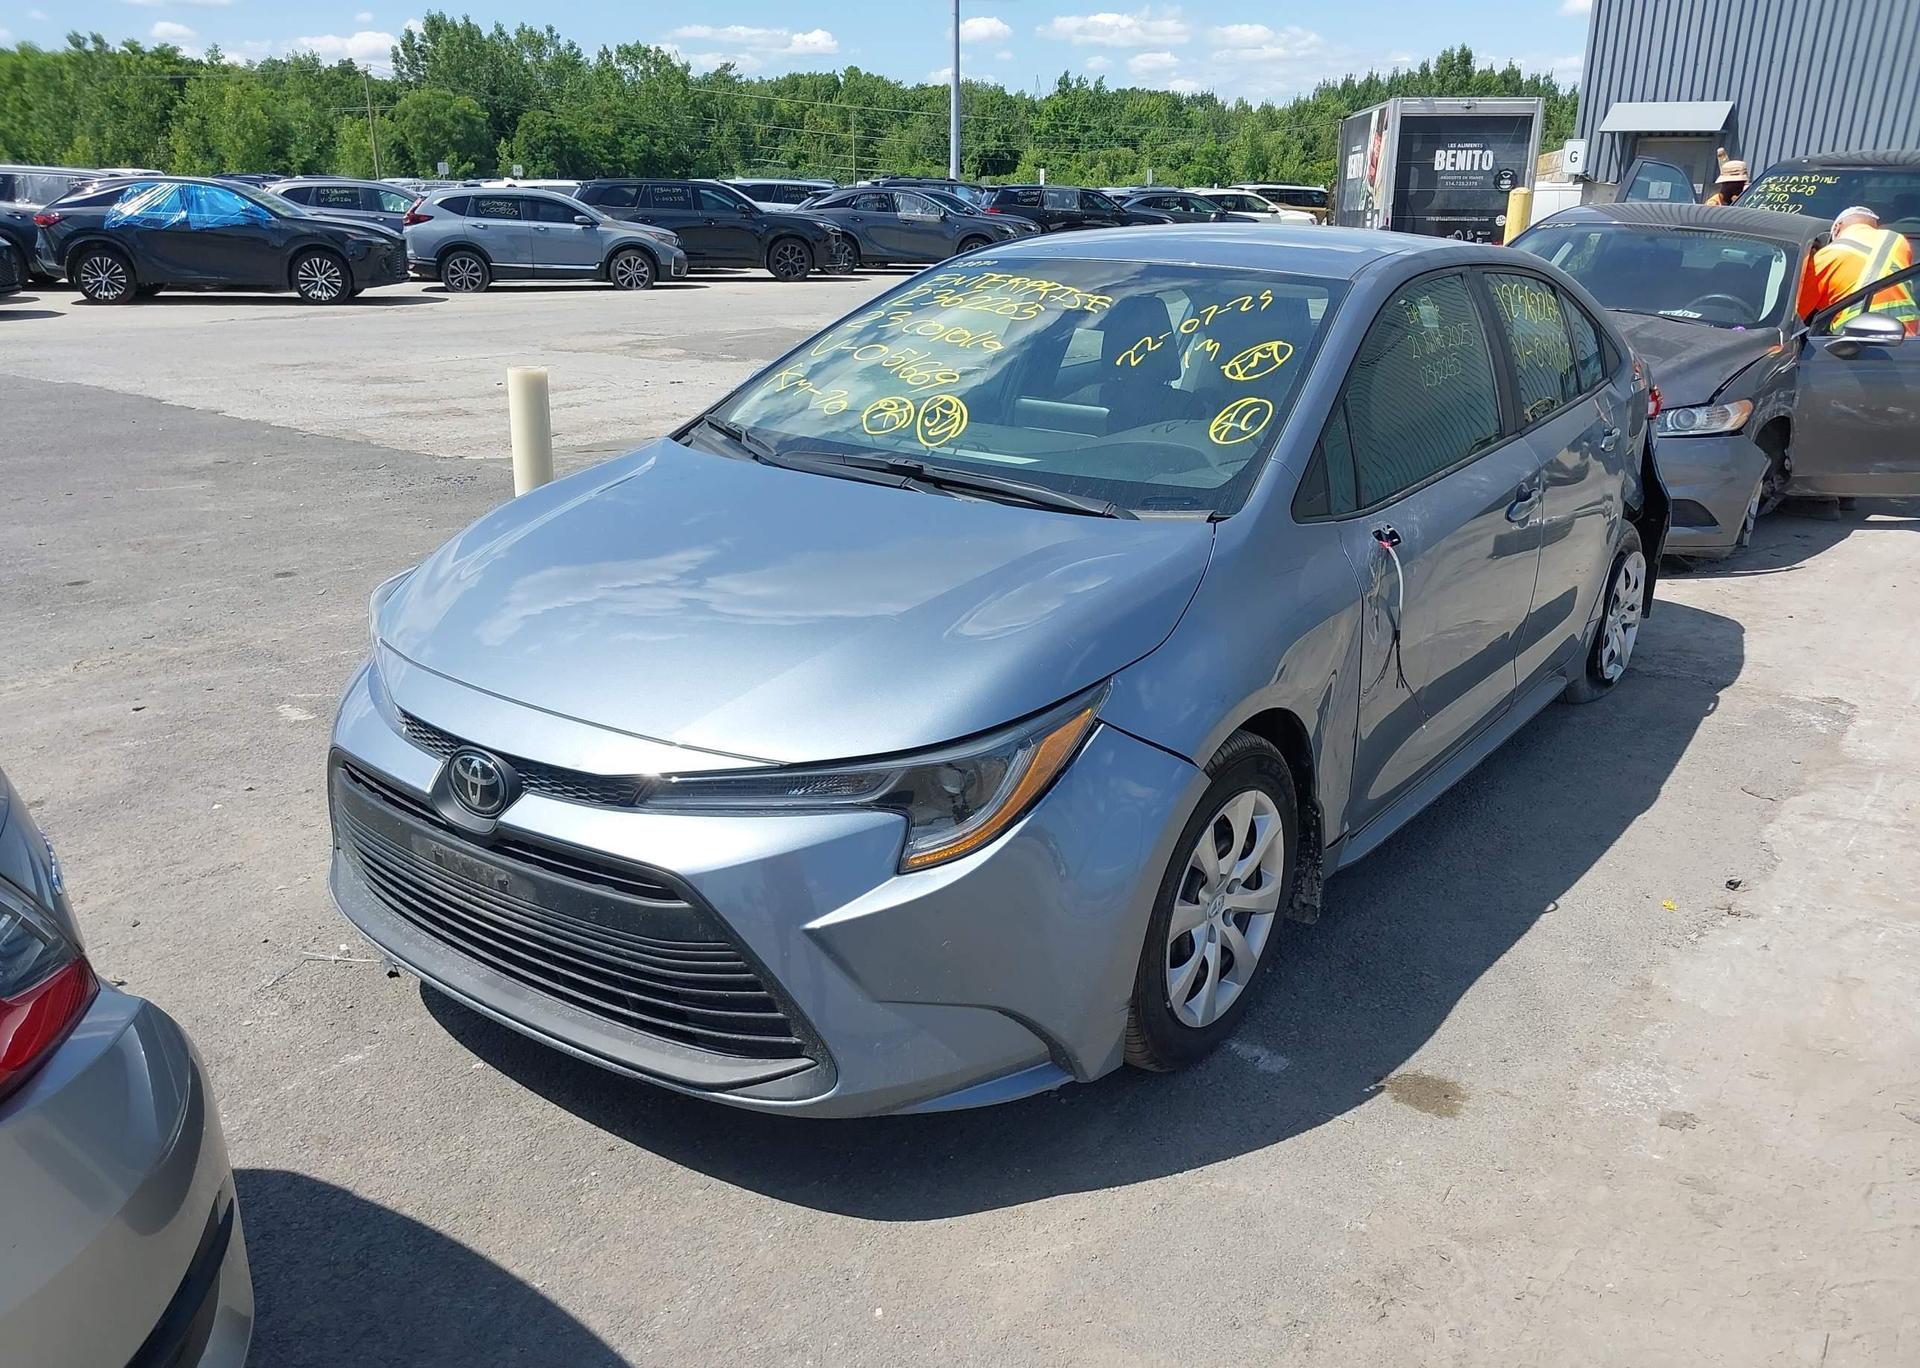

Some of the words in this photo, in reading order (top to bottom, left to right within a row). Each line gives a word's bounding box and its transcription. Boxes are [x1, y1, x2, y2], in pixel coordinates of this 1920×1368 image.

[1433, 150, 1494, 171] BENITO
[1569, 150, 1579, 163] G
[1755, 182, 1817, 197] 12365628
[881, 286, 1046, 321] 12362265
[915, 272, 1114, 315] ENTERPRISE
